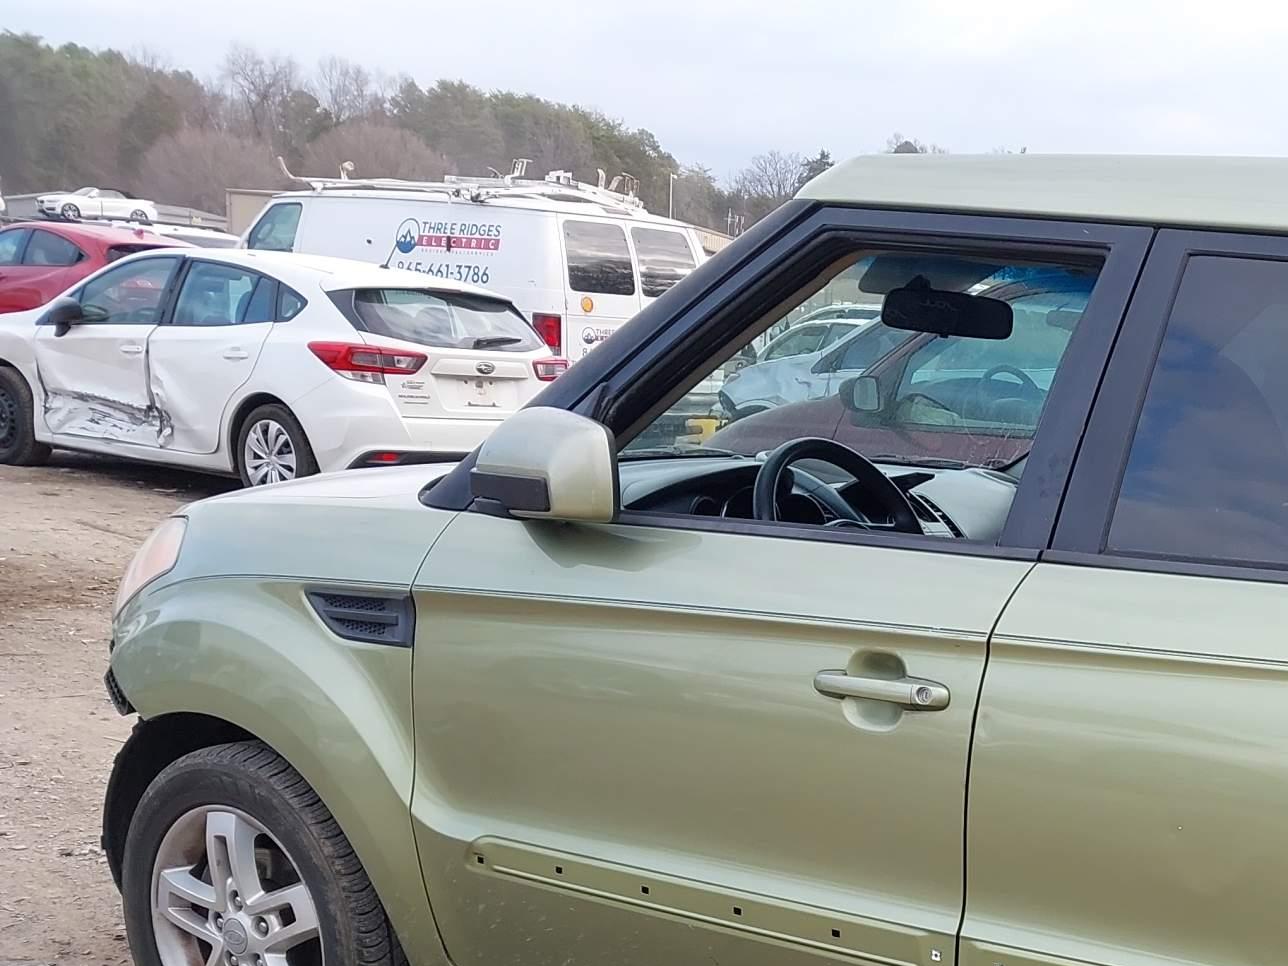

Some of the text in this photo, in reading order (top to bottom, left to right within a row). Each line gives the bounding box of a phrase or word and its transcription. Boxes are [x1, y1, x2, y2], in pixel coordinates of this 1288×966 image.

[422, 221, 502, 237] THREE RIDGES
[422, 236, 496, 249] ELECTRIC
